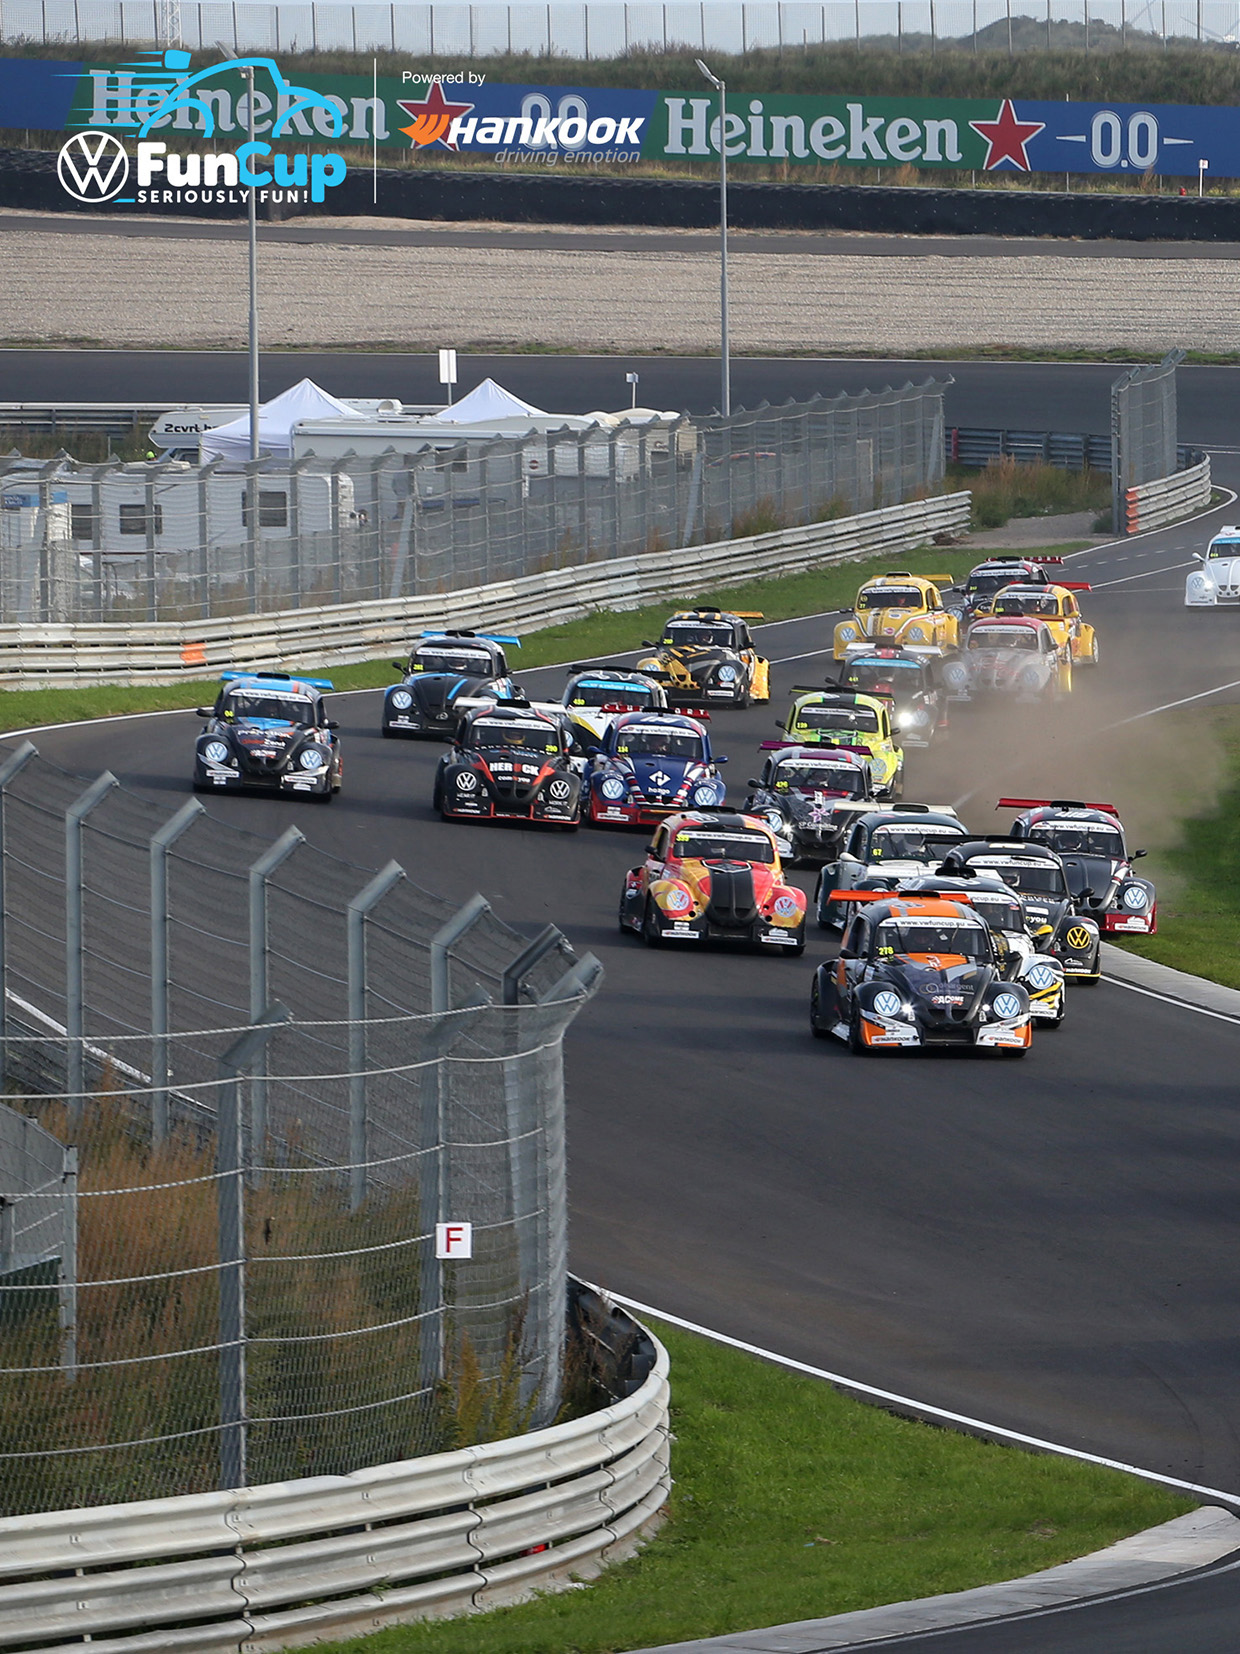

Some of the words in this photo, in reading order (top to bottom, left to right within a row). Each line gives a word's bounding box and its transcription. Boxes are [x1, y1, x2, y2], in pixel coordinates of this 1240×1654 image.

[88, 69, 390, 140] Heineken
[664, 97, 963, 163] Heineken
[446, 1227, 463, 1253] F
